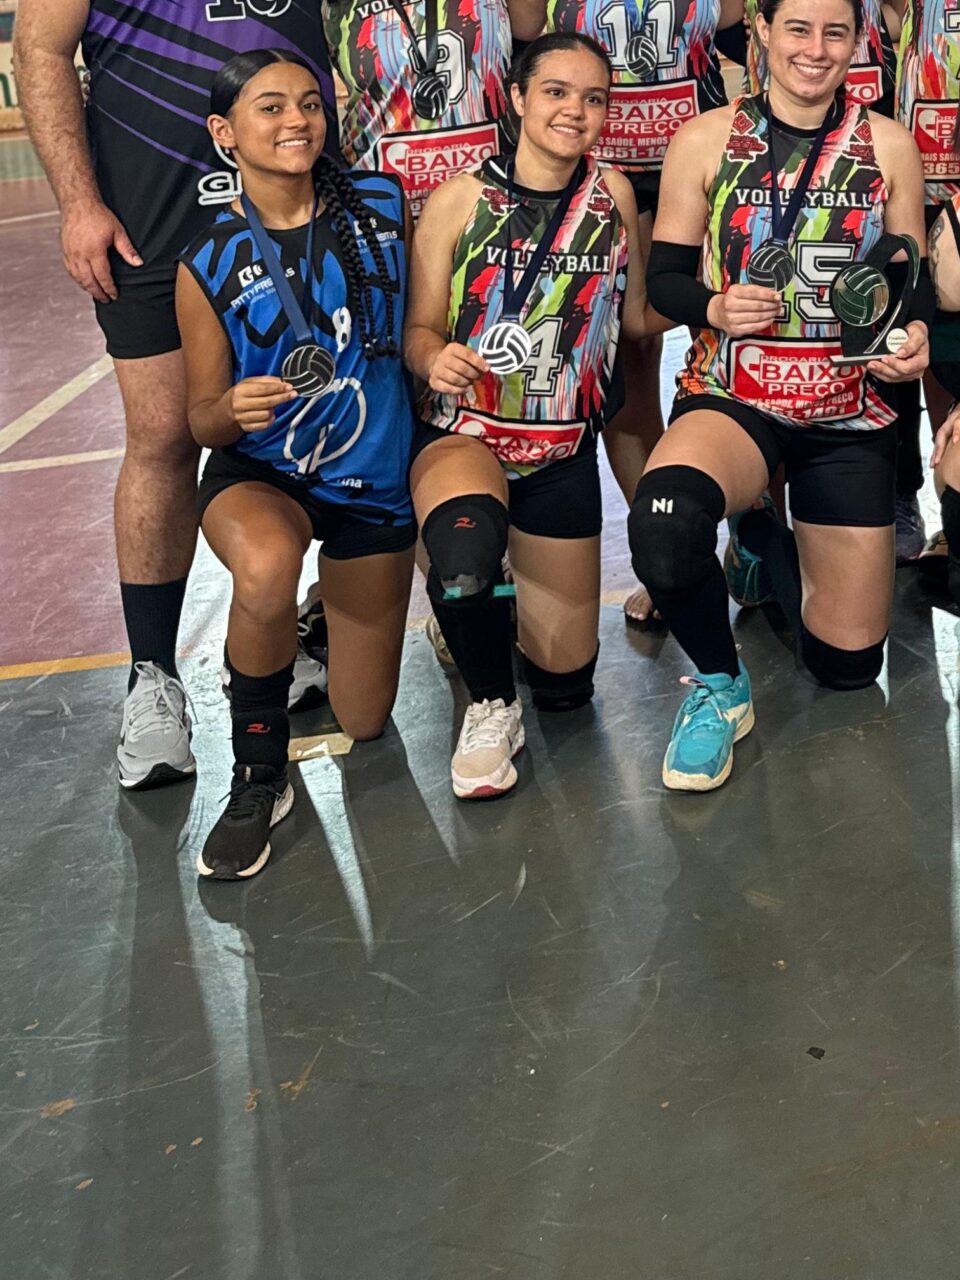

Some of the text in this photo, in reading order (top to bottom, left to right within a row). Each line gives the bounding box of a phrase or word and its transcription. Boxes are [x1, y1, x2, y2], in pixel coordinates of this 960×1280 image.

[407, 29, 468, 106] 9
[606, 100, 692, 122] BAIXO
[609, 119, 683, 135] PREÇO
[637, 136, 668, 147] MENOS
[407, 145, 495, 172] BAIXO
[591, 145, 667, 159] 3651-14
[520, 315, 564, 398] 4
[652, 497, 674, 514] N1
